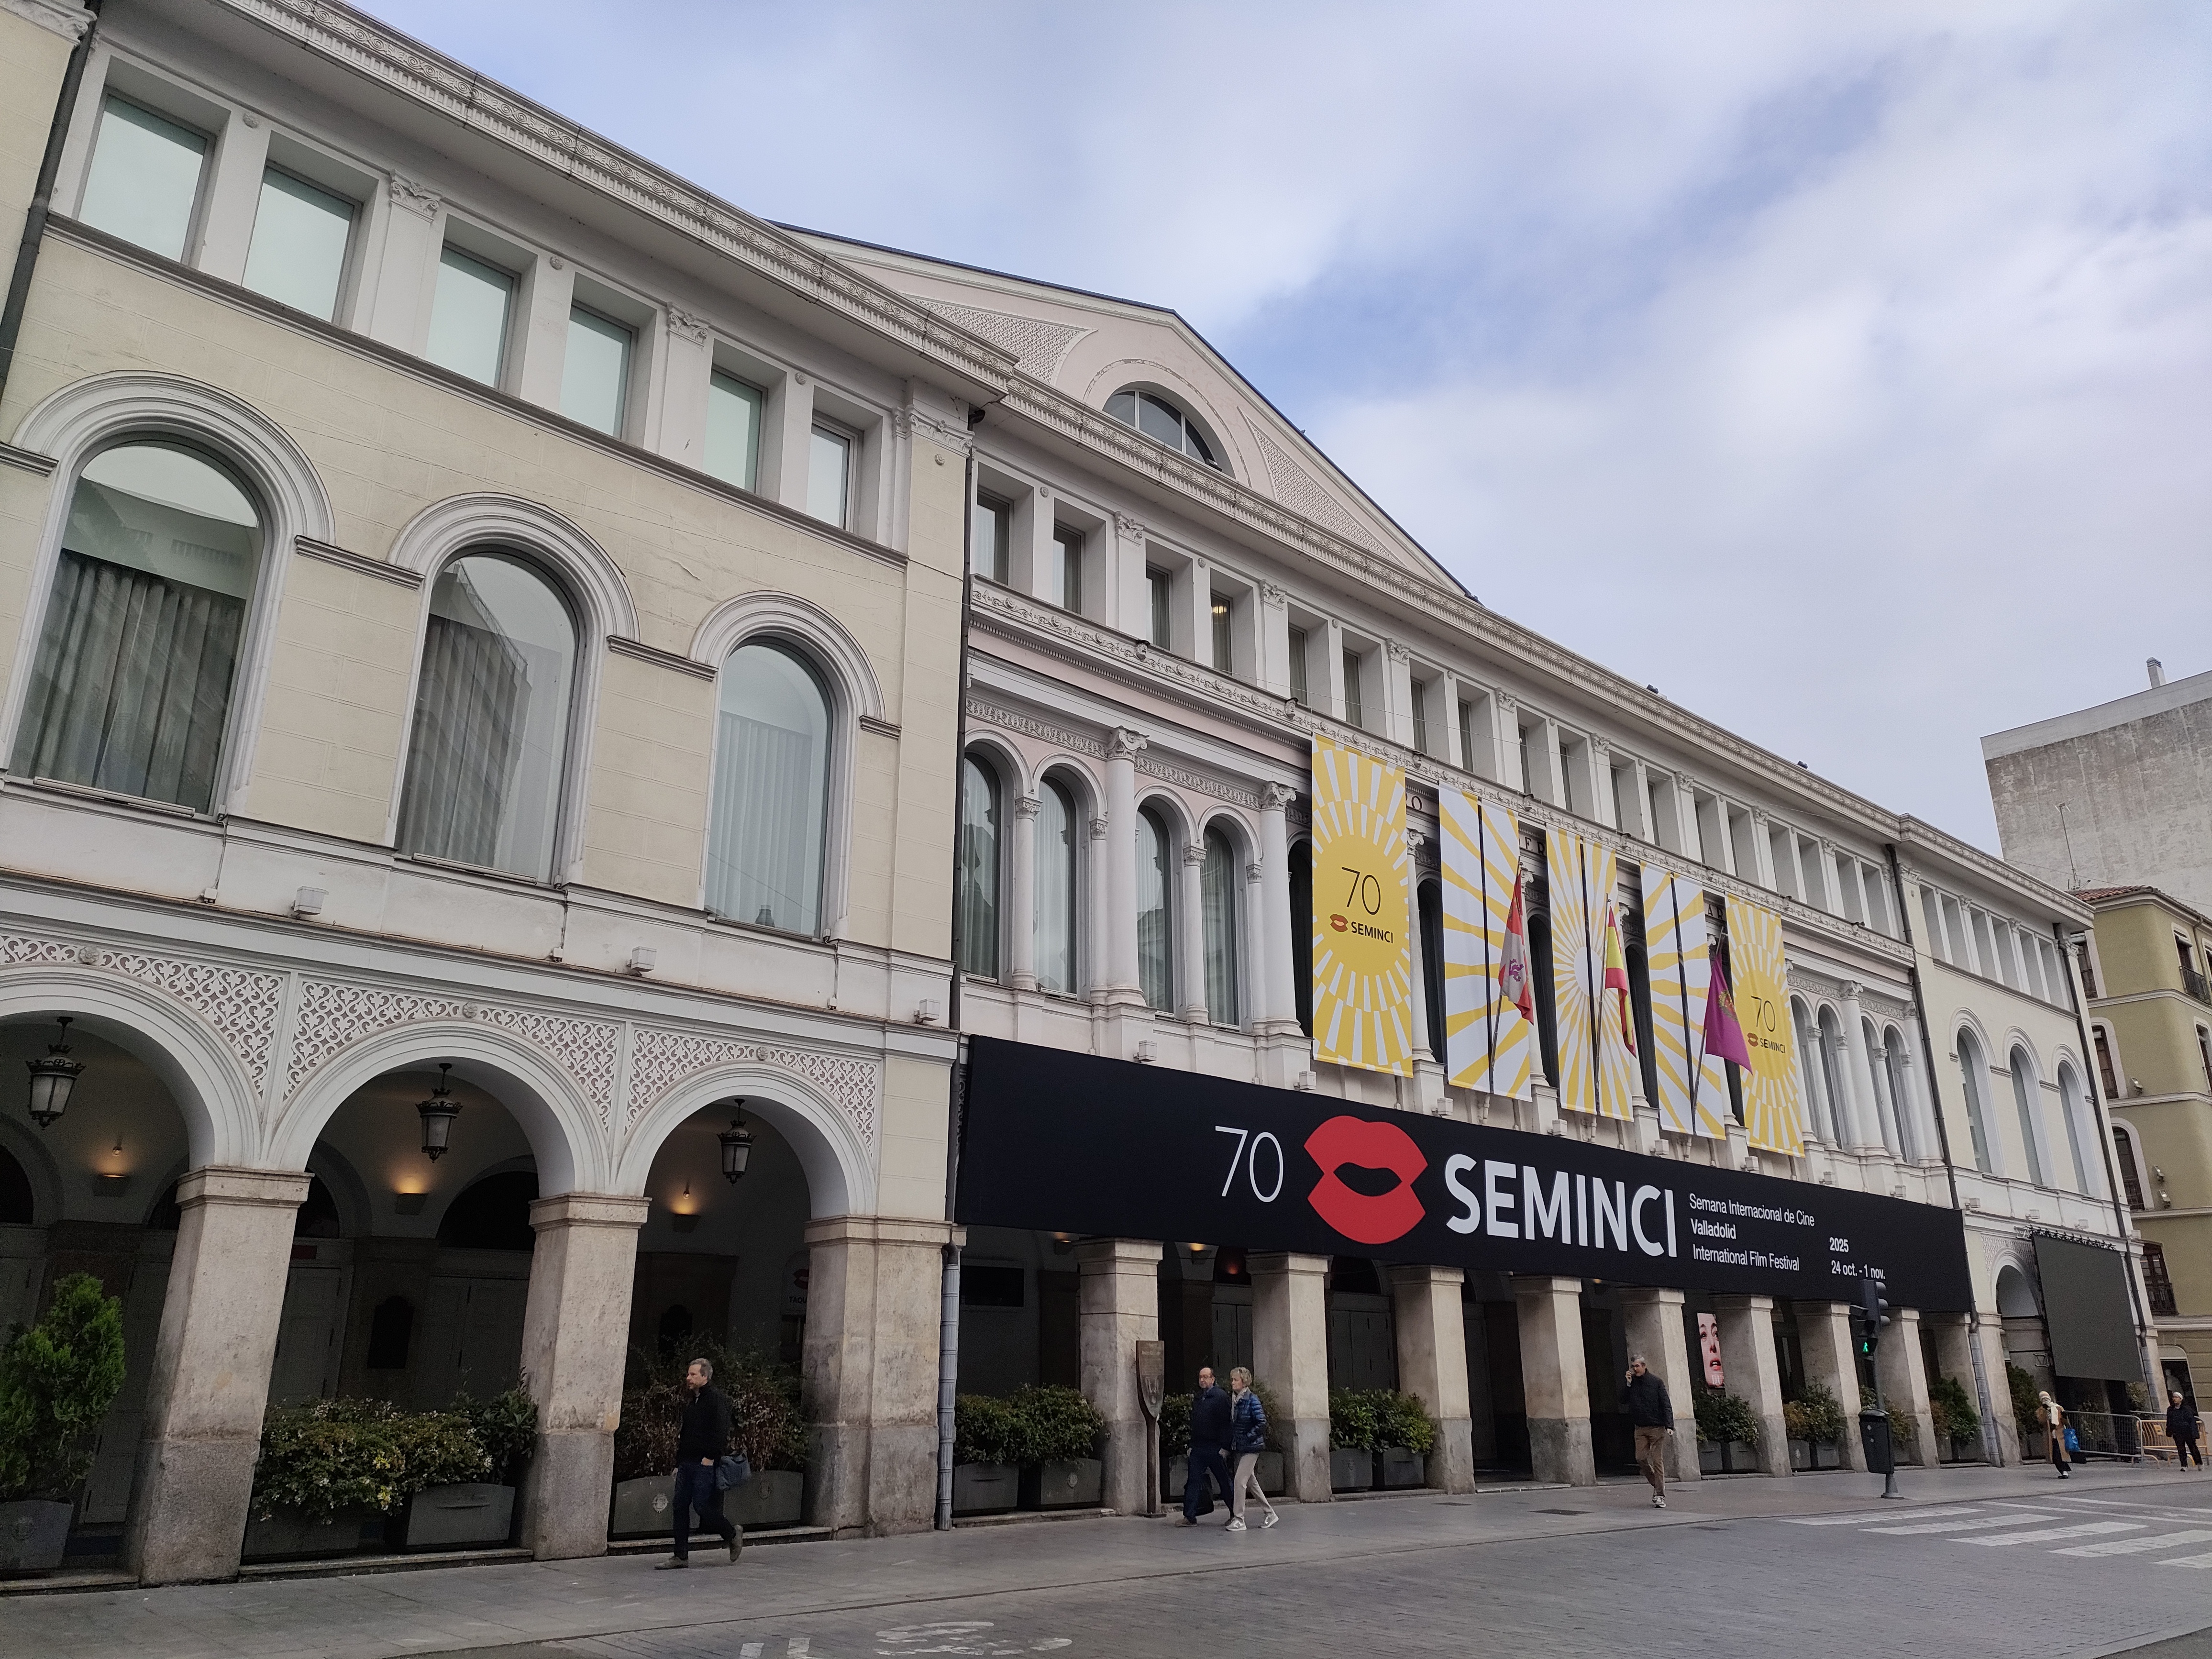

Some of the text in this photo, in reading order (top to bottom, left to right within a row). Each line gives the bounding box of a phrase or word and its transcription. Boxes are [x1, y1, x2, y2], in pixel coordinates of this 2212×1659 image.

[1341, 867, 1381, 915] 70
[1351, 922, 1393, 943] SEMINCI
[1751, 995, 1775, 1032] 70
[1760, 1038, 1785, 1053] SEMINCI
[1216, 1126, 1676, 1257] 70 SEMINCI
[1690, 1194, 1814, 1226] Semana Internacional de Cine
[1691, 1218, 1736, 1239] Valladolid
[1830, 1237, 1848, 1252] 2025
[1693, 1244, 1799, 1271] International Film Festival
[1832, 1260, 1841, 1274] 24
[1843, 1263, 1857, 1276] oct.
[1864, 1264, 1868, 1277] 1
[1871, 1268, 1885, 1279] nov.
